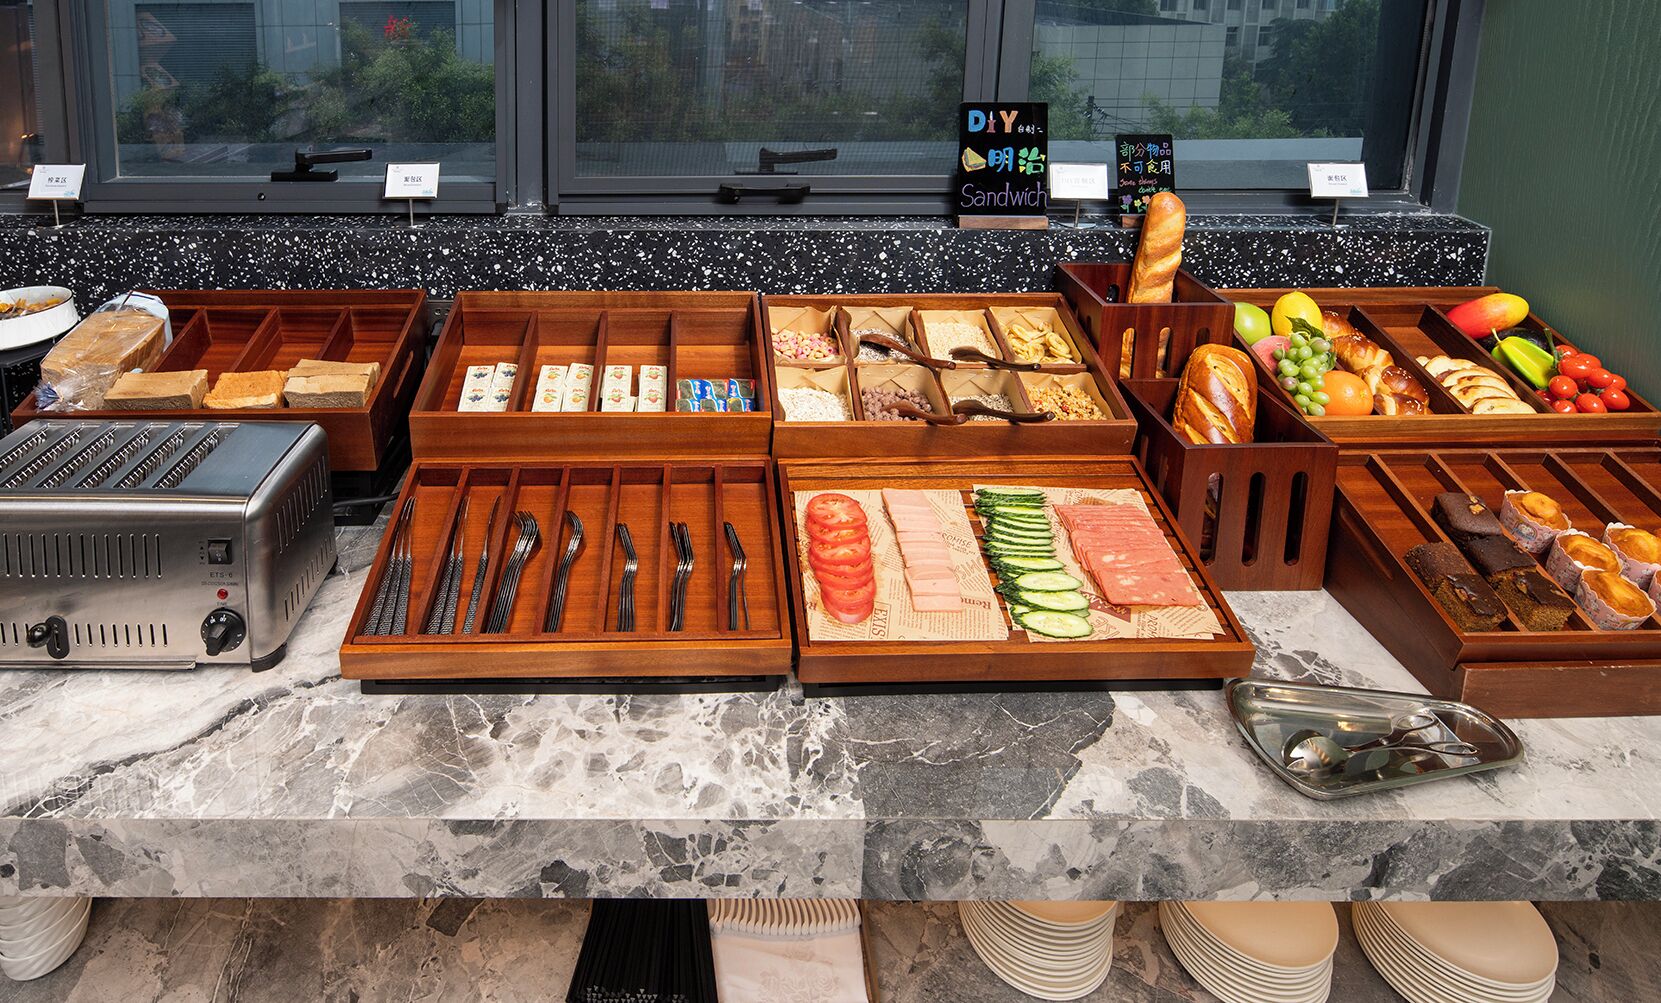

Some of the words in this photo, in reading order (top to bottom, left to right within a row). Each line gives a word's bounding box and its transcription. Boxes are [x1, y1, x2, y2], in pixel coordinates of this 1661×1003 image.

[968, 110, 1018, 133] DIY
[988, 146, 1046, 175] 明治
[1120, 141, 1172, 161] 部分物品
[1120, 159, 1171, 175] 不可食用
[960, 181, 1048, 208] Sandwich
[871, 608, 888, 639] EXIS
